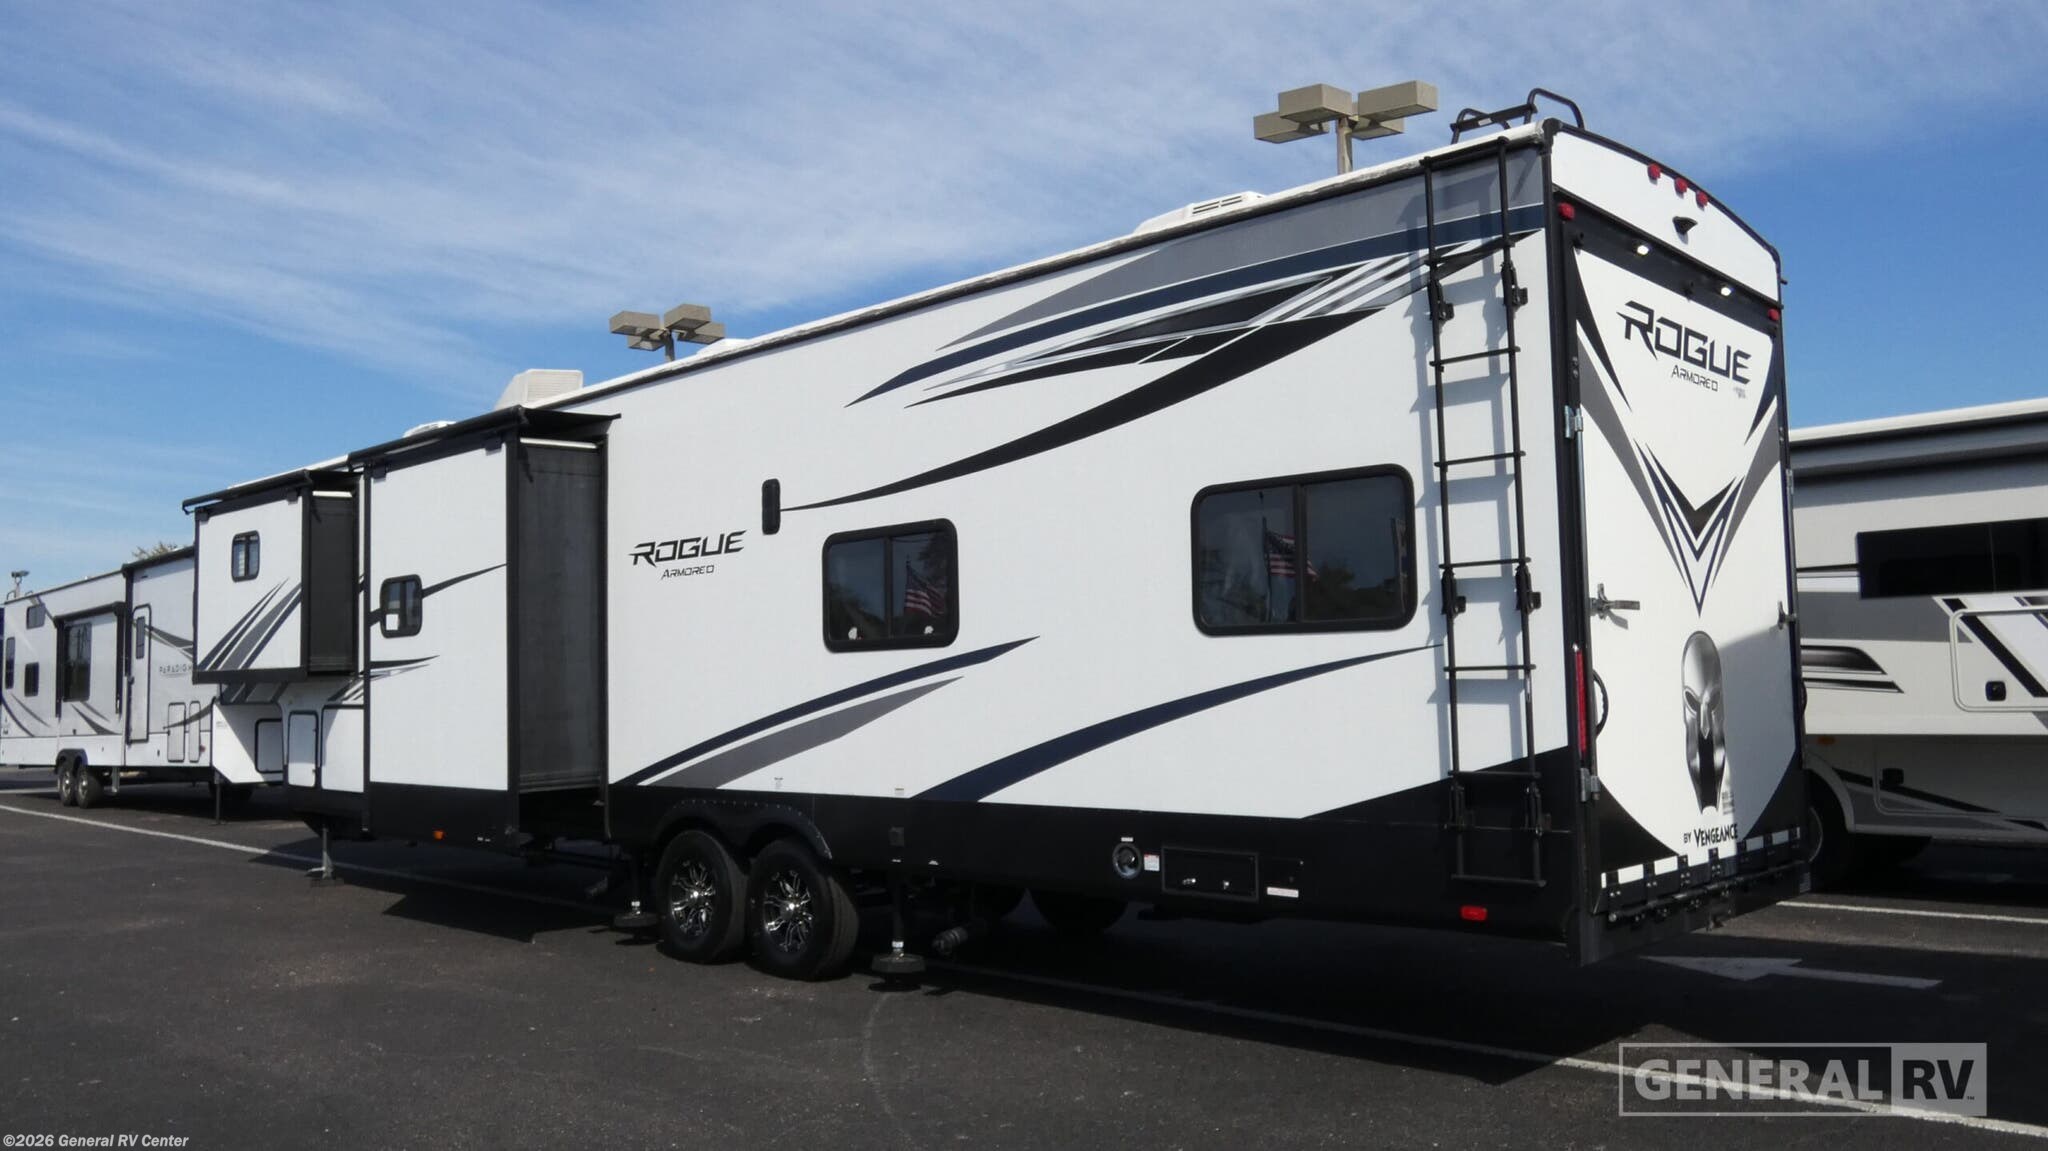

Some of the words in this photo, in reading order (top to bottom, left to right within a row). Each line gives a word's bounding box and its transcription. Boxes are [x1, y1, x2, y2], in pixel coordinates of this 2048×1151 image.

[1616, 300, 1752, 385] ROGUE
[1671, 364, 1719, 392] ARMORED
[628, 530, 747, 568] ROGUE
[661, 564, 715, 580] ARMORED
[1683, 832, 1692, 843] BY
[1694, 823, 1738, 848] VENGEANCE
